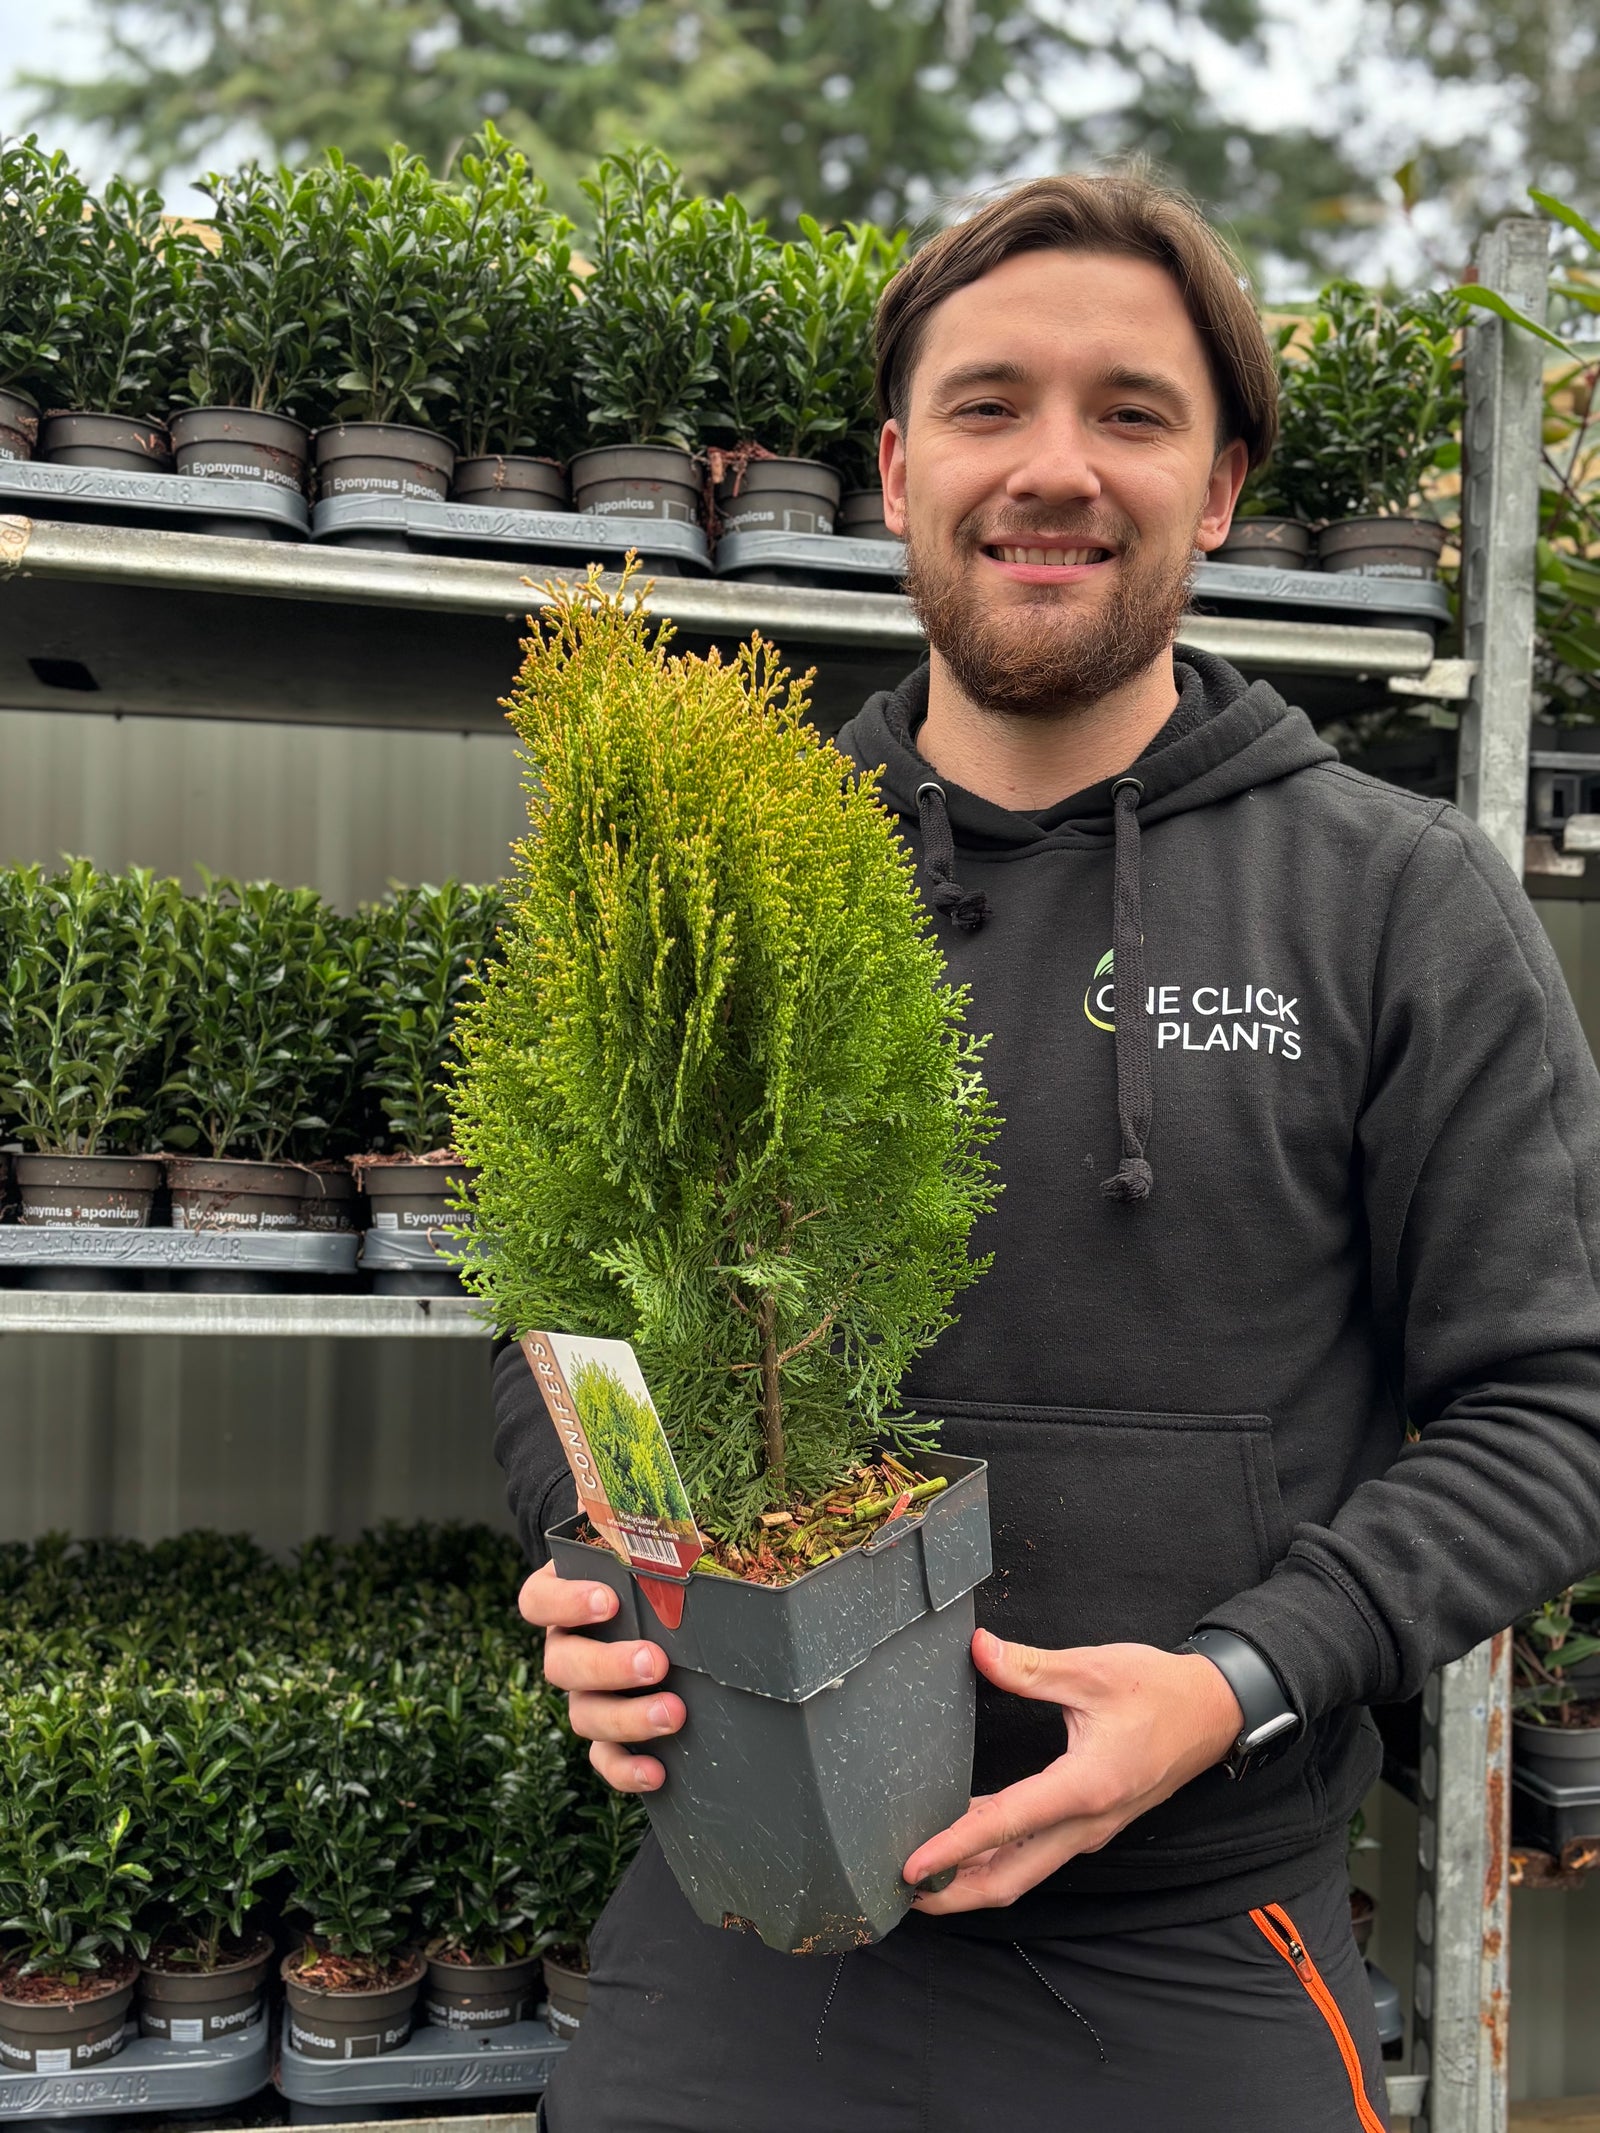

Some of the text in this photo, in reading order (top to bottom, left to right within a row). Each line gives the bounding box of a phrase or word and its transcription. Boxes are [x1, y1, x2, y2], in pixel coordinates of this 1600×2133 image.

[192, 461, 261, 478] Eyonymus
[333, 477, 399, 495] Eyonymus
[593, 497, 655, 518] japonicus
[1192, 984, 1300, 1026] CLICK
[1157, 1021, 1302, 1061] PLANTS
[403, 1212, 471, 1226] Eyonymus
[530, 1342, 597, 1489] CONIFERS
[448, 2007, 511, 2022] japonicus
